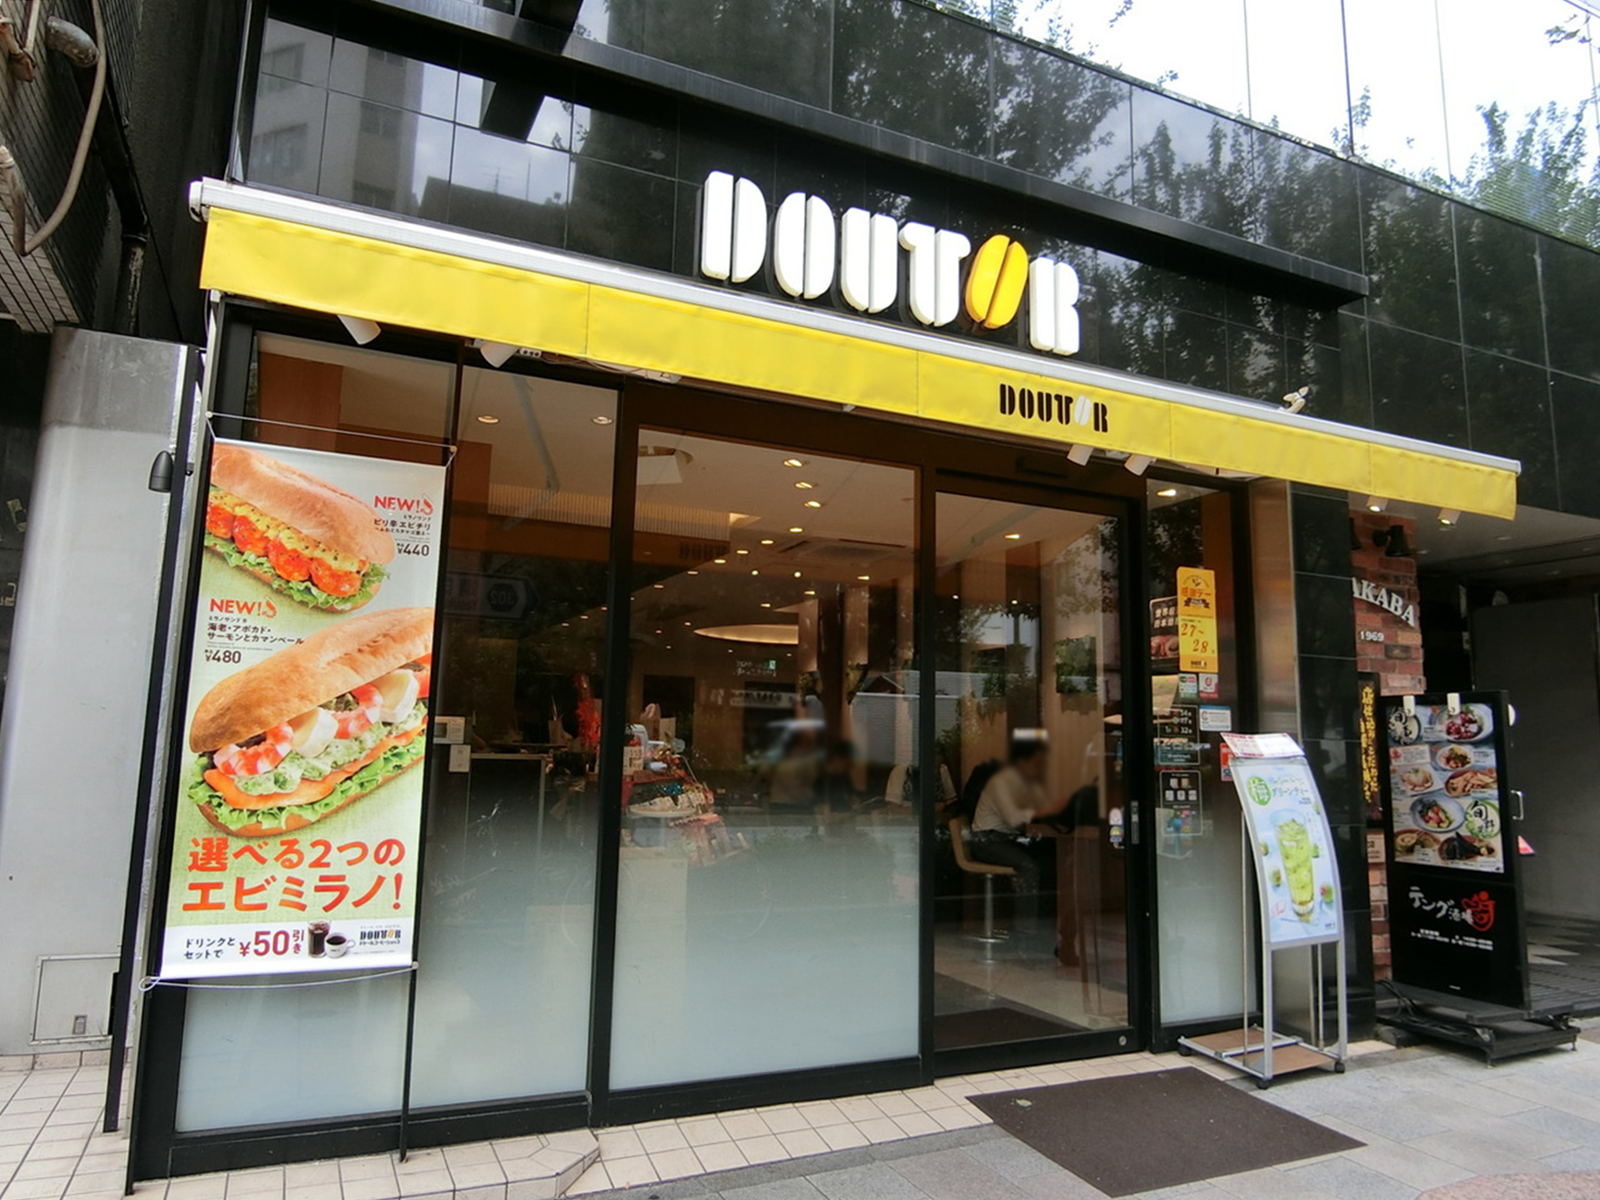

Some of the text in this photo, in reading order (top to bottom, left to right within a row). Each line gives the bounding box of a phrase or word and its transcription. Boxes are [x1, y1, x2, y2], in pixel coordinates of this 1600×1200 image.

[701, 170, 1080, 356] DOUTOR
[999, 383, 1109, 433] DOUTOR
[374, 495, 420, 513] NEW!
[210, 598, 262, 616] NEW!
[1360, 631, 1384, 641] 1969
[187, 837, 406, 873] 選べる2つの
[182, 872, 404, 912] エビミラノ!
[186, 936, 235, 949] ドリンクと
[184, 949, 224, 960] セットで
